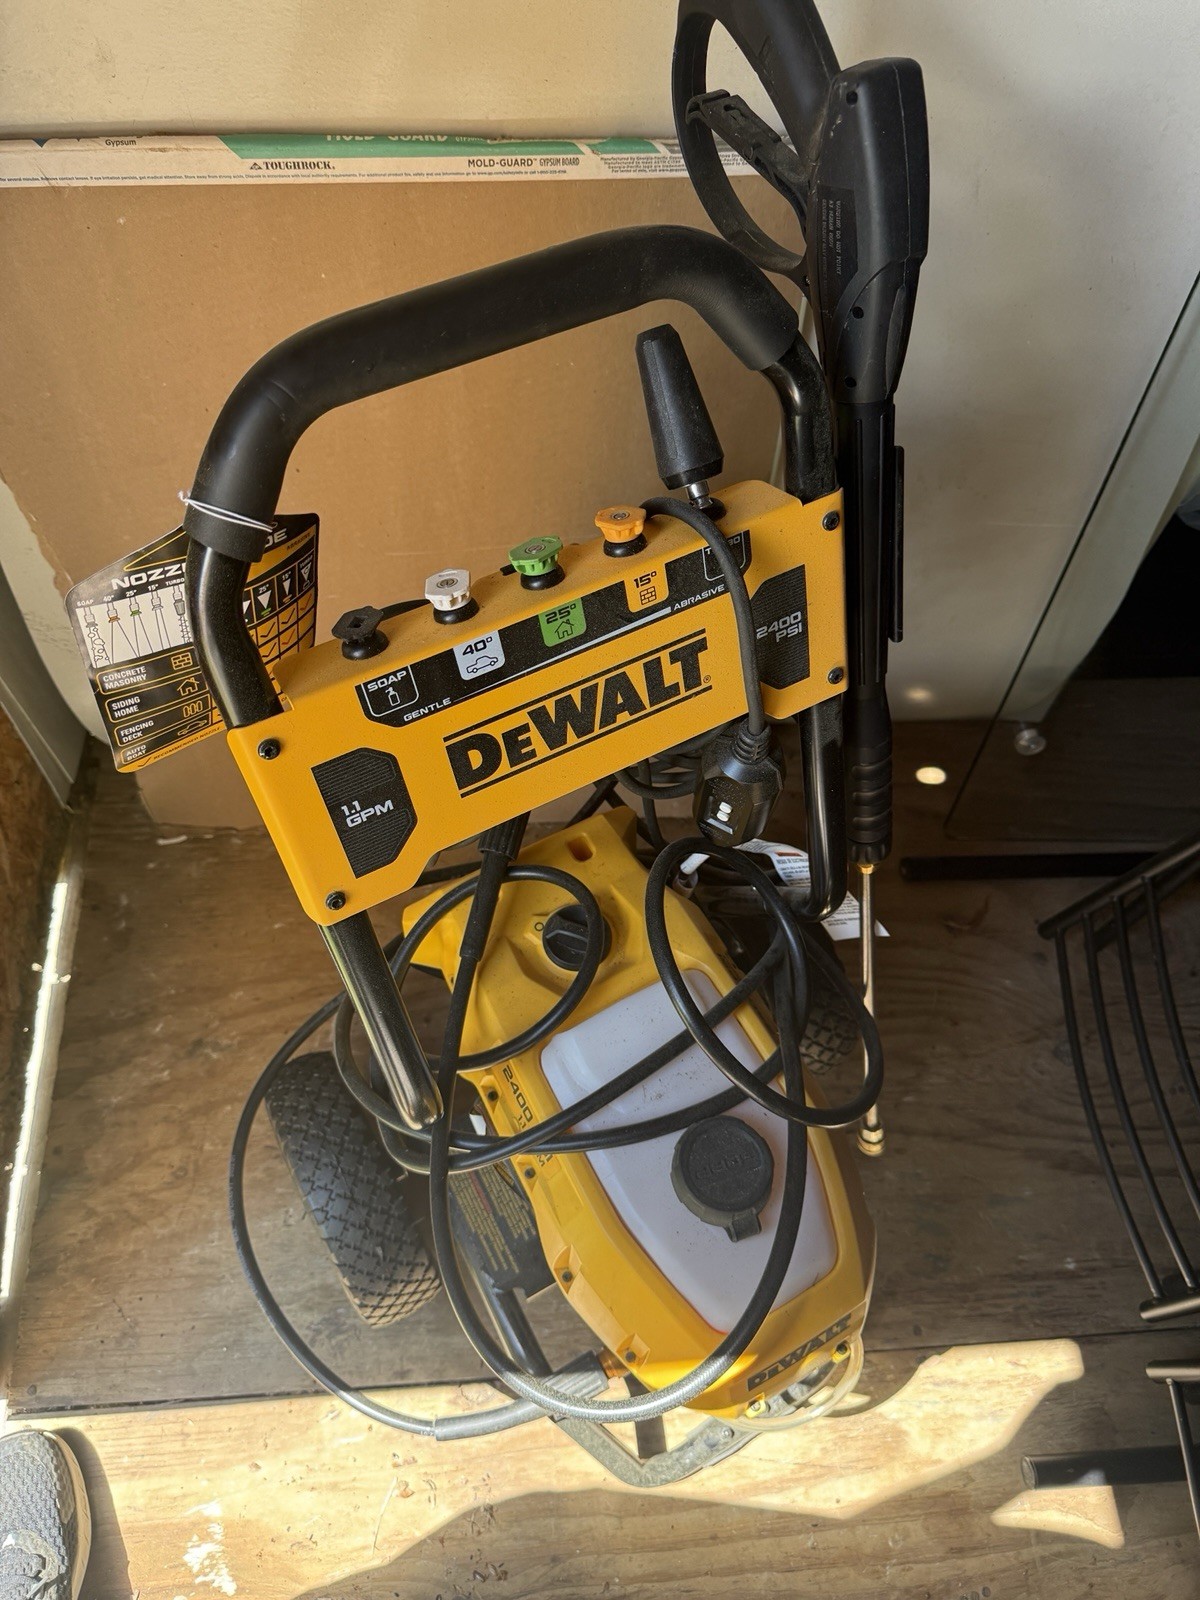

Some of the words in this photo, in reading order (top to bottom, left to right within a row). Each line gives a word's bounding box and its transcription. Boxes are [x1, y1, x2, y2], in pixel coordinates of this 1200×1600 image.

[105, 139, 137, 148] Gypsum
[539, 157, 561, 167] GYPSUM
[561, 157, 580, 166] BOARD
[112, 563, 186, 591] NOZZ
[165, 578, 185, 586] TURBO
[634, 571, 657, 588] 15°
[125, 589, 137, 598] 25°
[147, 583, 158, 592] 15°
[76, 599, 94, 607] SOAP
[673, 584, 725, 611] ABRASIVE
[545, 603, 577, 624] 25°
[756, 611, 802, 640] 2400
[775, 622, 803, 643] PSI
[462, 636, 492, 656] 40°
[102, 665, 147, 683] CONCRETE
[104, 673, 148, 690] MASONRY
[366, 670, 407, 692] SOAP
[112, 696, 141, 710] SIDING
[114, 705, 140, 718] HOME
[403, 697, 452, 722] GENTLE
[120, 720, 154, 737] FENCING
[122, 731, 144, 744] DECK
[125, 744, 147, 757] AUTO
[126, 750, 147, 762] BOAT
[341, 800, 361, 816] 1.1
[346, 800, 394, 827] GPM
[502, 1064, 534, 1123] 2400
